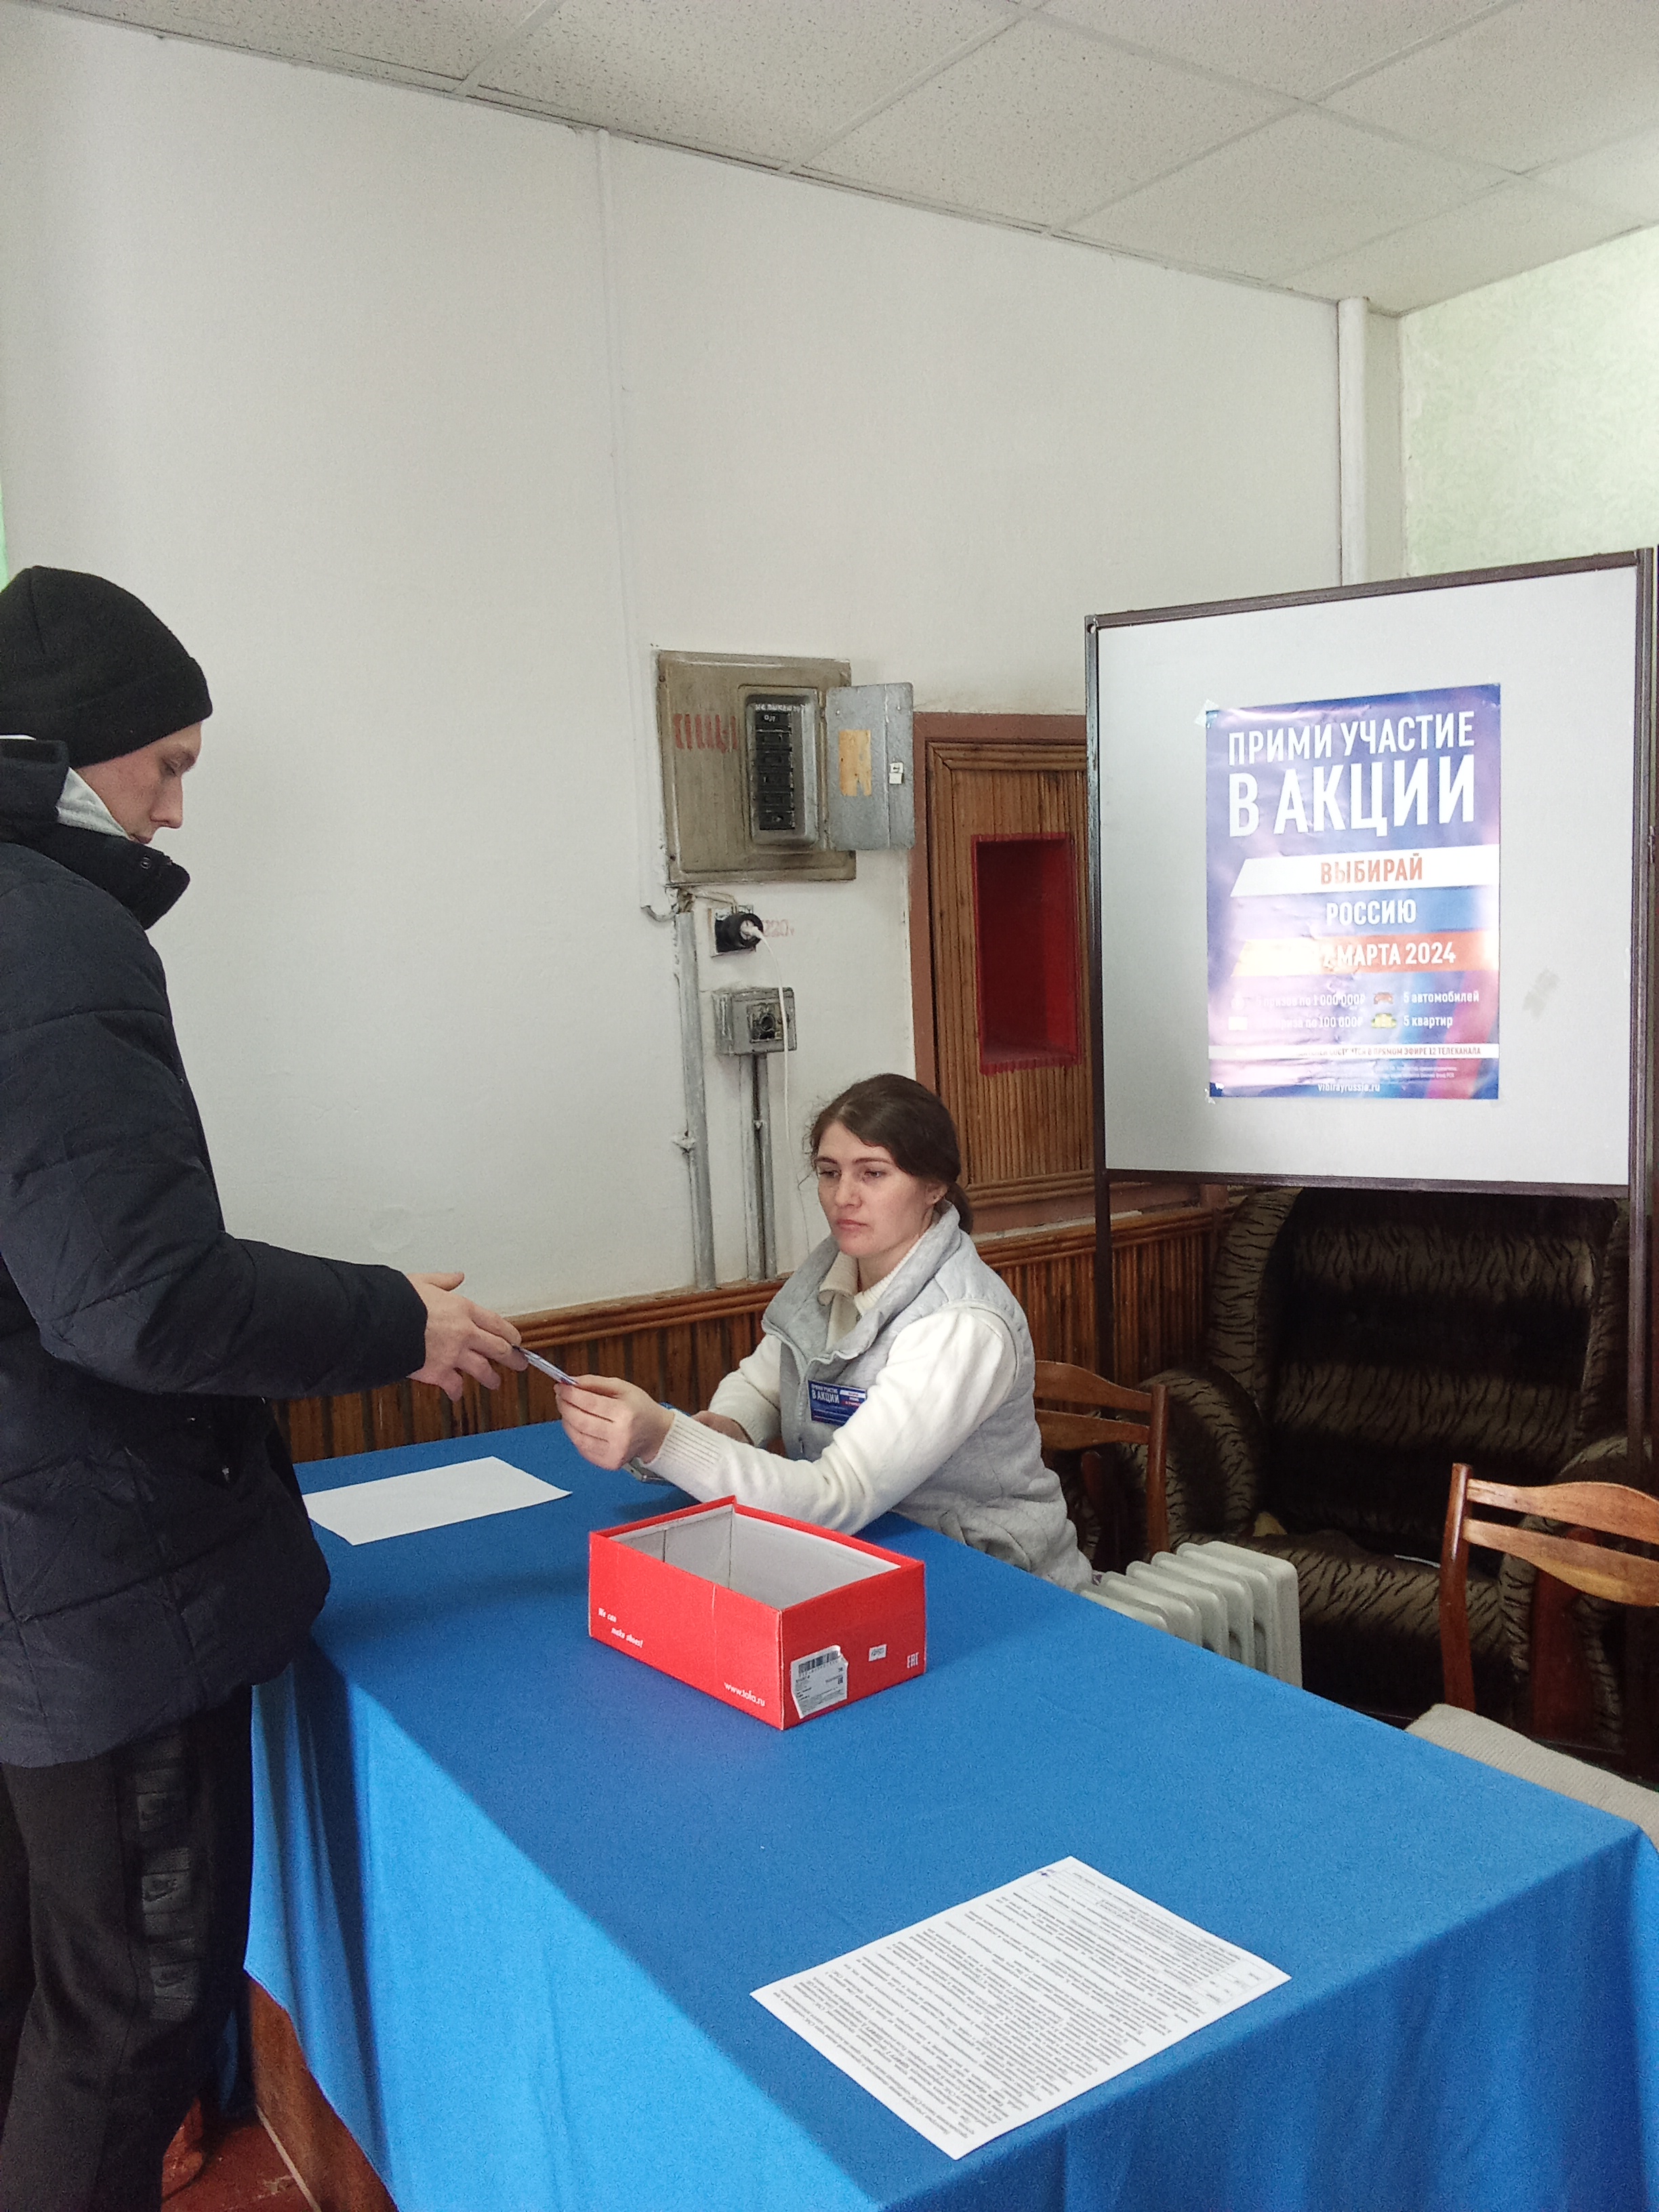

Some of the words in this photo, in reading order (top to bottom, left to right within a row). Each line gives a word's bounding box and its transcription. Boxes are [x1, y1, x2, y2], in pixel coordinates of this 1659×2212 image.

[1229, 724, 1332, 766] ПРИМИ
[1340, 710, 1475, 756] УЧАСТИЕ
[1229, 772, 1260, 837] В
[1273, 754, 1475, 837] АКЦИИ
[1321, 853, 1422, 884] ВЫБИРАЙ
[1326, 899, 1417, 926] РОССИЮ
[1337, 943, 1401, 967] МАРТА
[1405, 941, 1456, 965] 2024
[1403, 991, 1410, 1003] 5
[1412, 989, 1479, 1003] автомобилей
[1403, 1017, 1410, 1027] 5
[1412, 1016, 1453, 1029] квартир
[1429, 1047, 1437, 1055] 12
[1438, 1047, 1481, 1055] ТЕЛЕКАНАЛА
